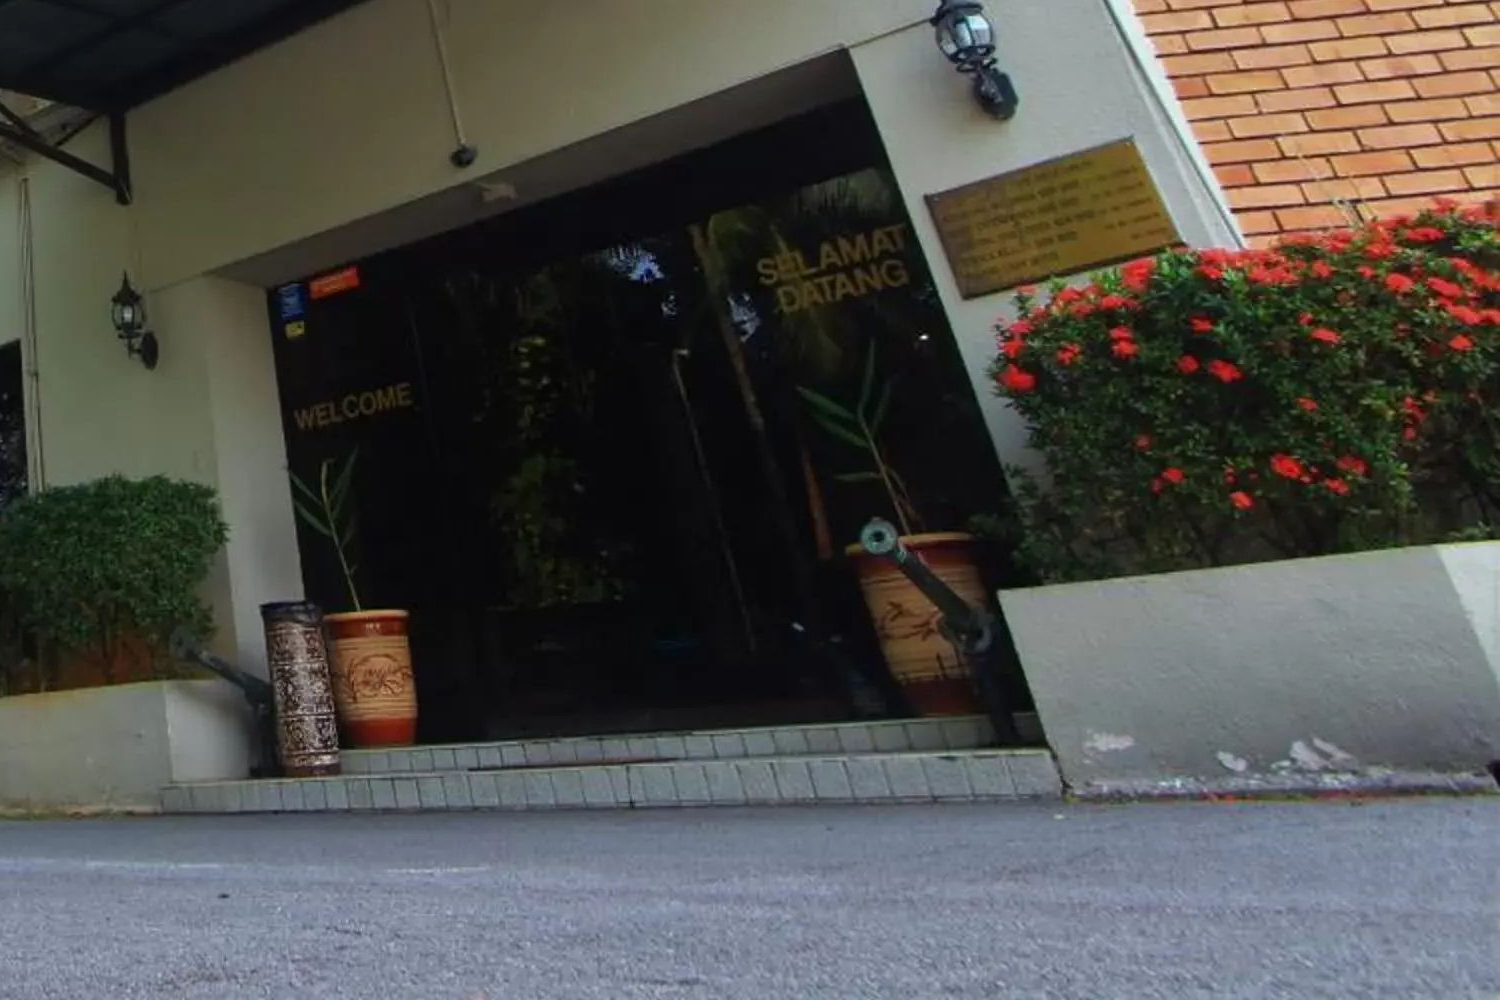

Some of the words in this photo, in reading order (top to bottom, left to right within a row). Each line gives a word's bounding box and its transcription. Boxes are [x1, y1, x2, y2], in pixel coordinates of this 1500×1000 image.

[757, 223, 906, 285] SELAMAT
[776, 259, 908, 313] DATANG
[294, 382, 412, 429] WELCOME
